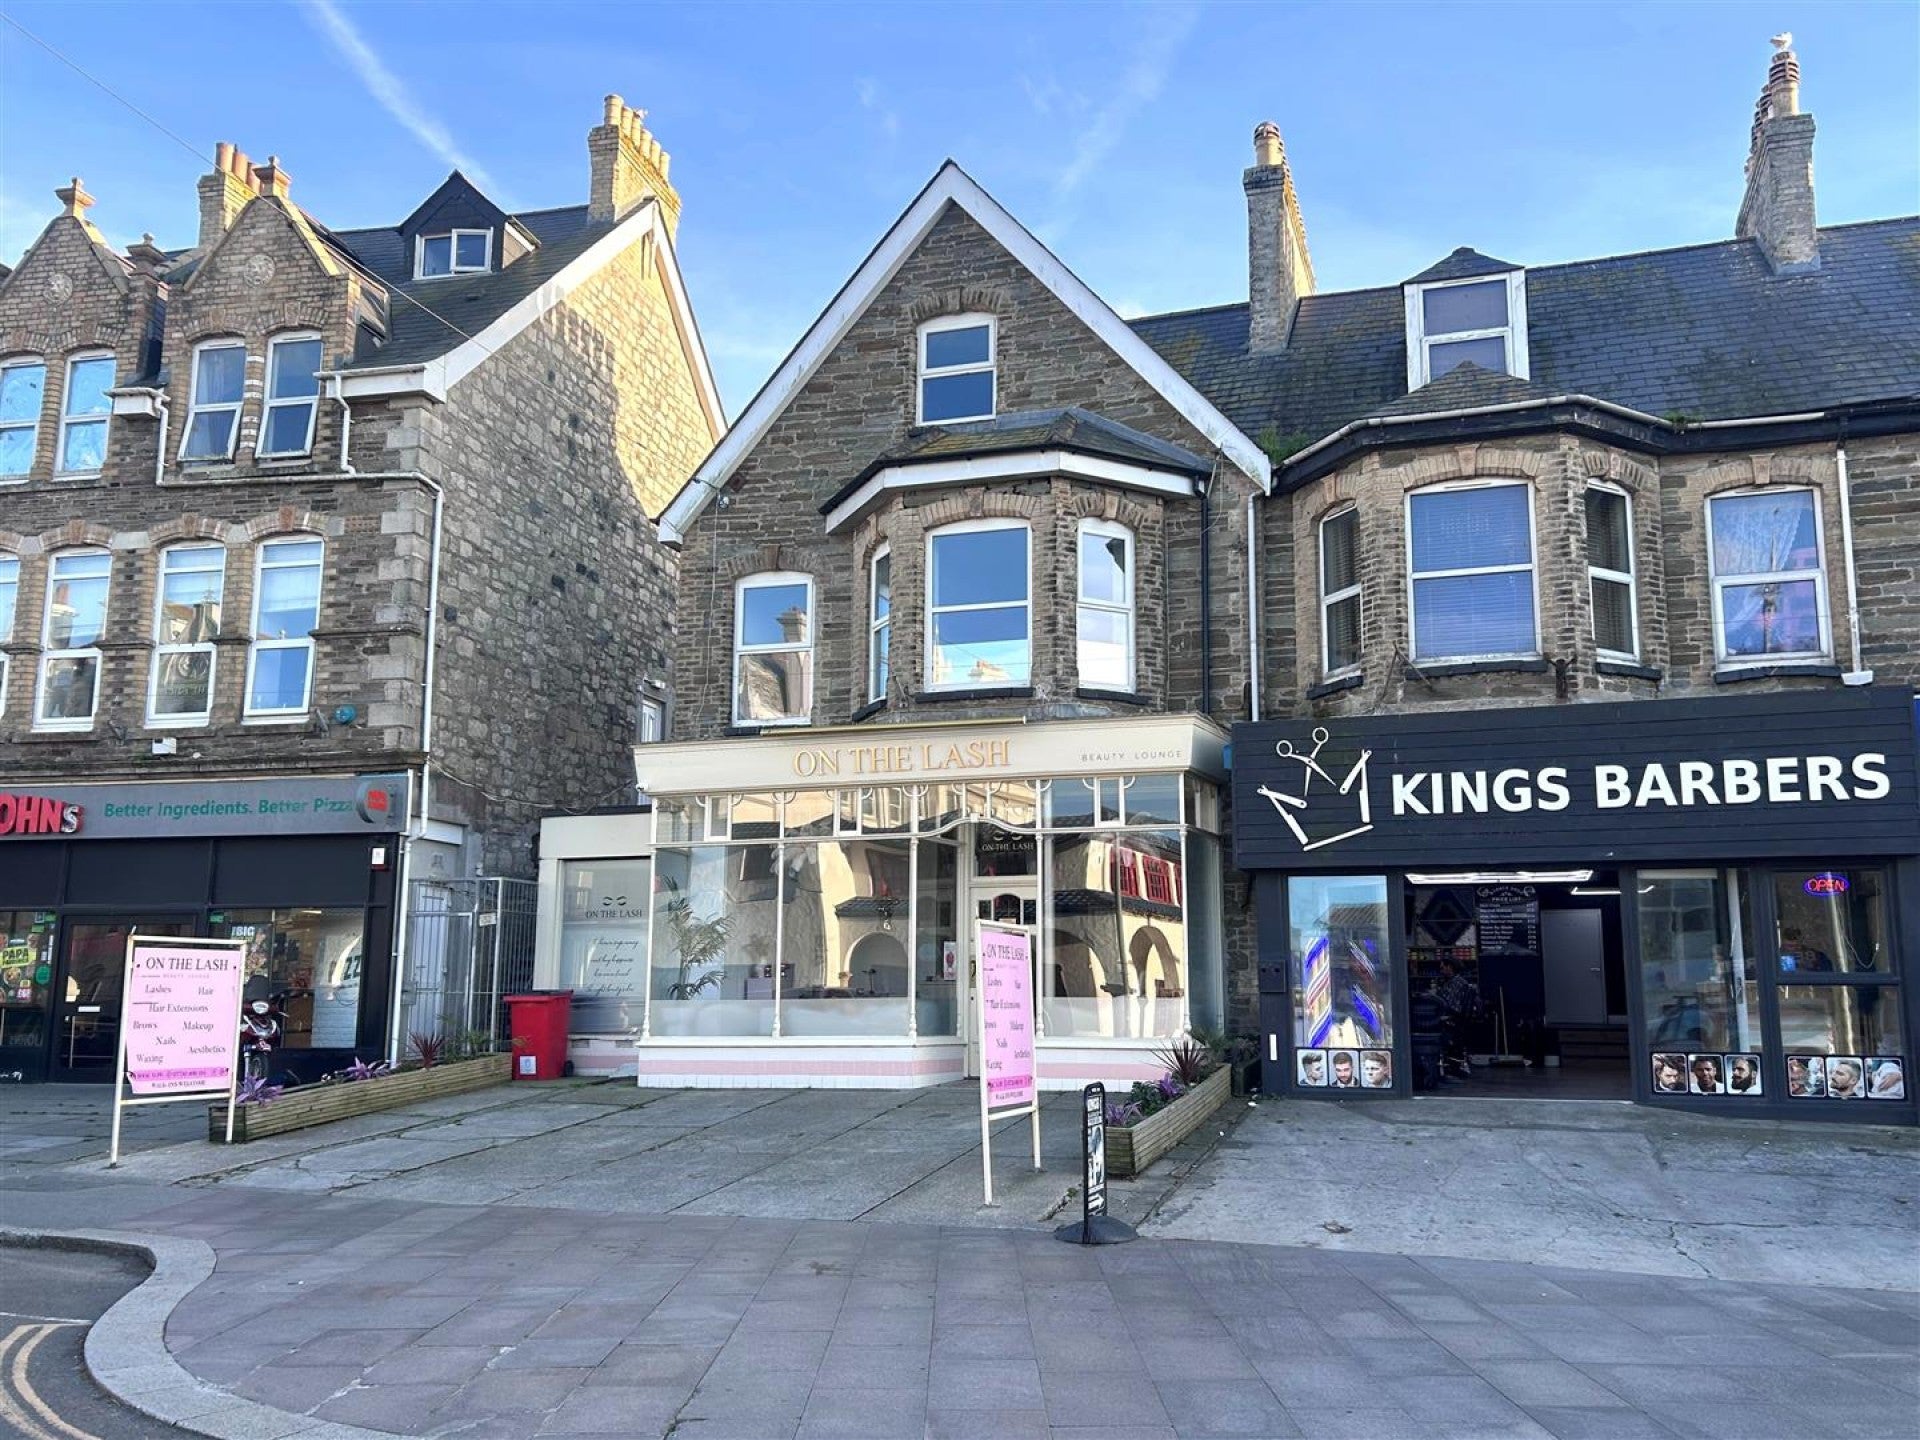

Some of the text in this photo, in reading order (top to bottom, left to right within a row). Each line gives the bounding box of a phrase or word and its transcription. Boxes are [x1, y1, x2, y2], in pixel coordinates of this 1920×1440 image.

[793, 737, 1012, 777] ON THE LASH
[1081, 750, 1184, 761] BEAUTY LOUNGE
[1392, 752, 1892, 816] KINGS BARBERS
[104, 803, 153, 818] Better
[157, 798, 252, 820] Ingredients.
[1807, 878, 1845, 892] OPEN
[146, 957, 228, 971] ON THE LASH
